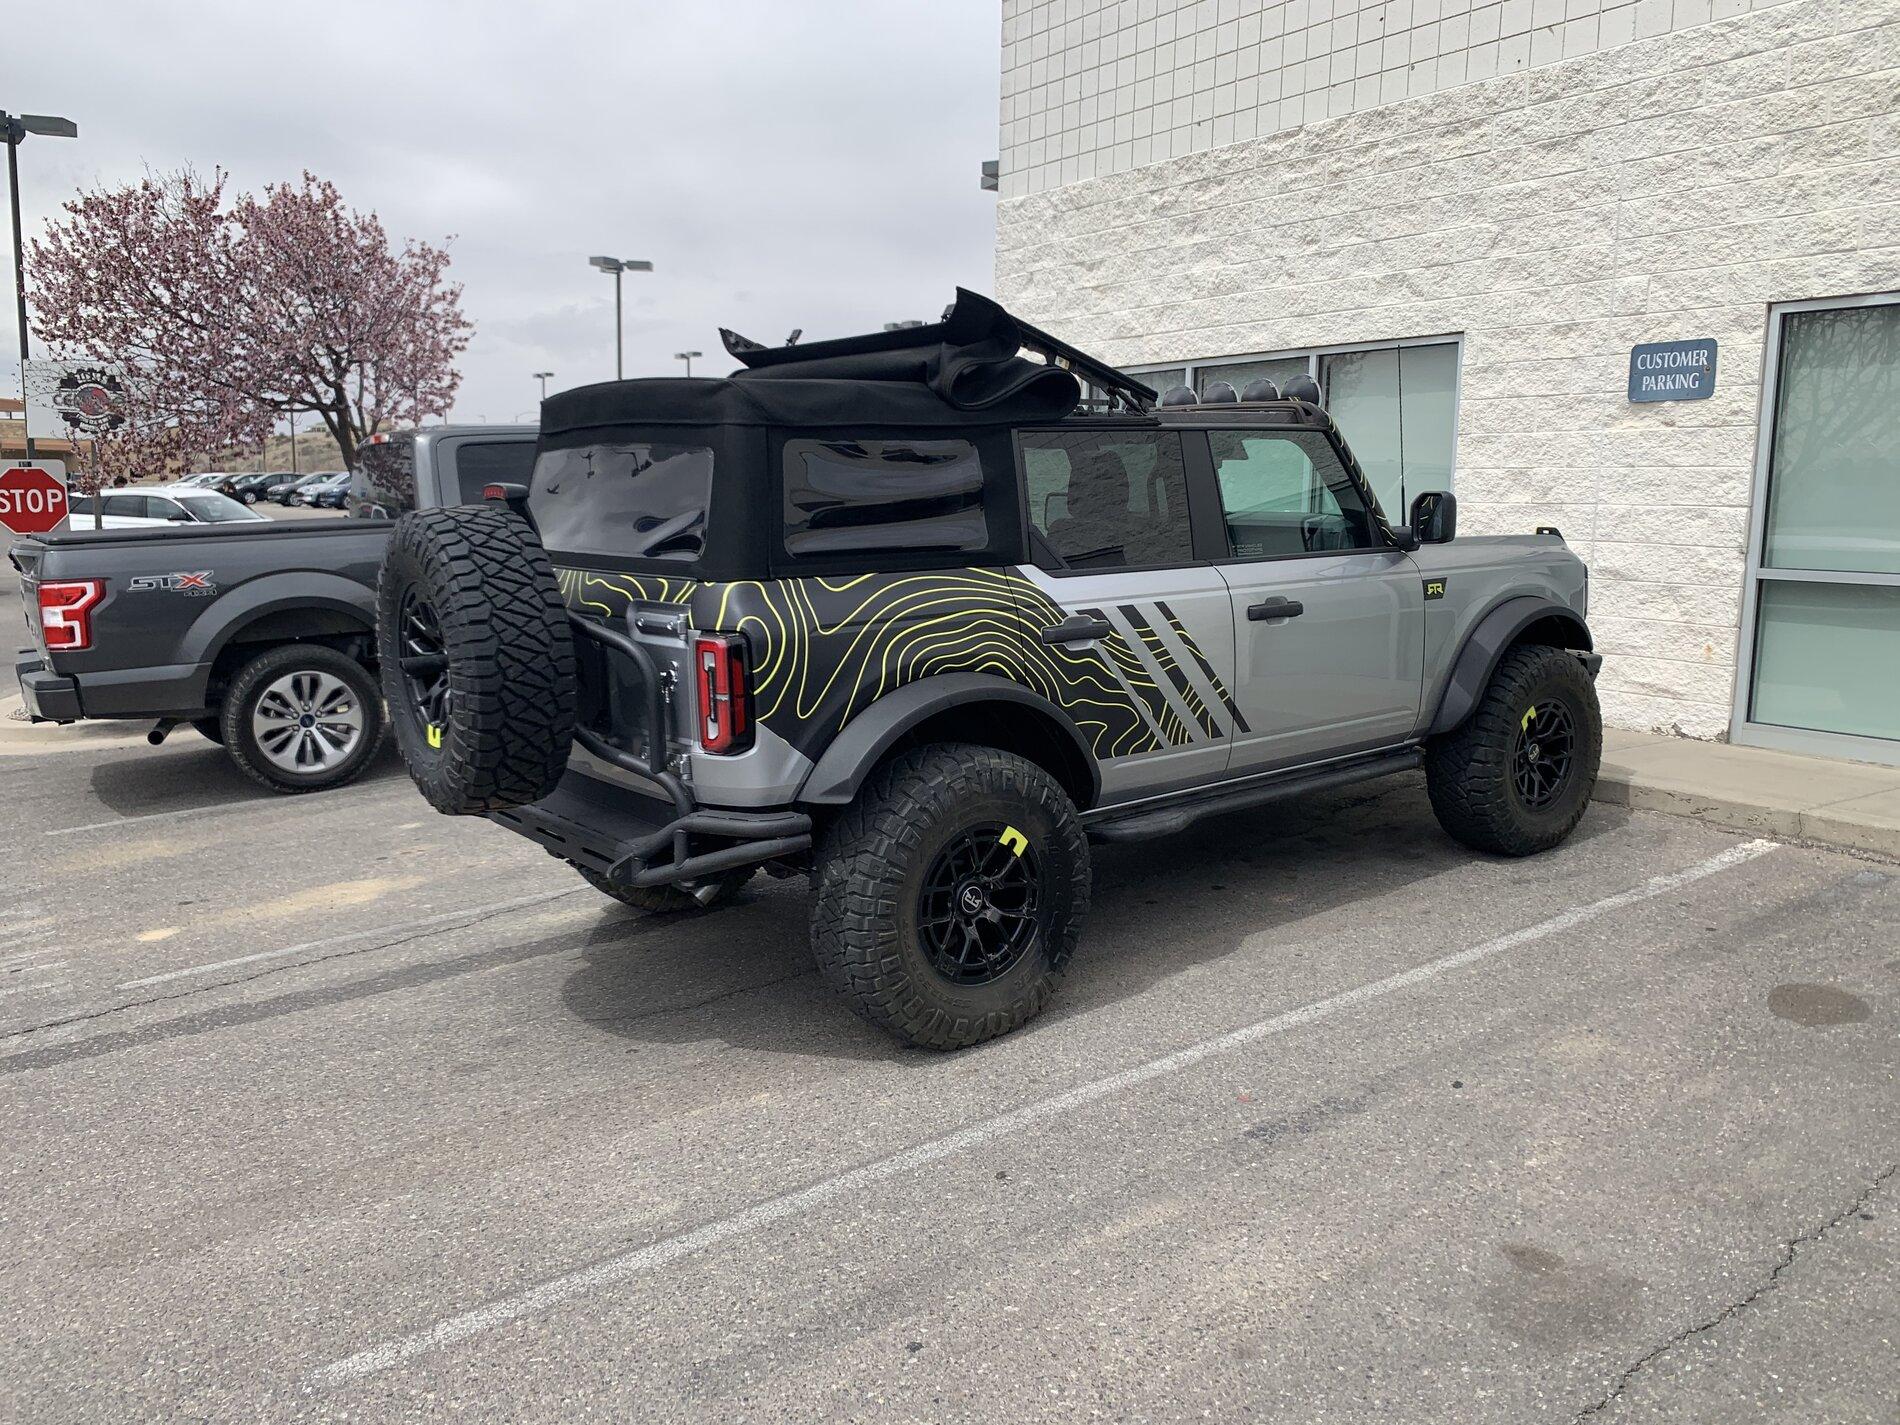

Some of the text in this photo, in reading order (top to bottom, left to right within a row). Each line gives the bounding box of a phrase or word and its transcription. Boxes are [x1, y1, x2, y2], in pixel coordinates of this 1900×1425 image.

[1637, 349, 1708, 370] CUSTOMER
[1642, 372, 1700, 391] PARKING
[0, 488, 63, 513] STOP
[127, 570, 216, 592] STX
